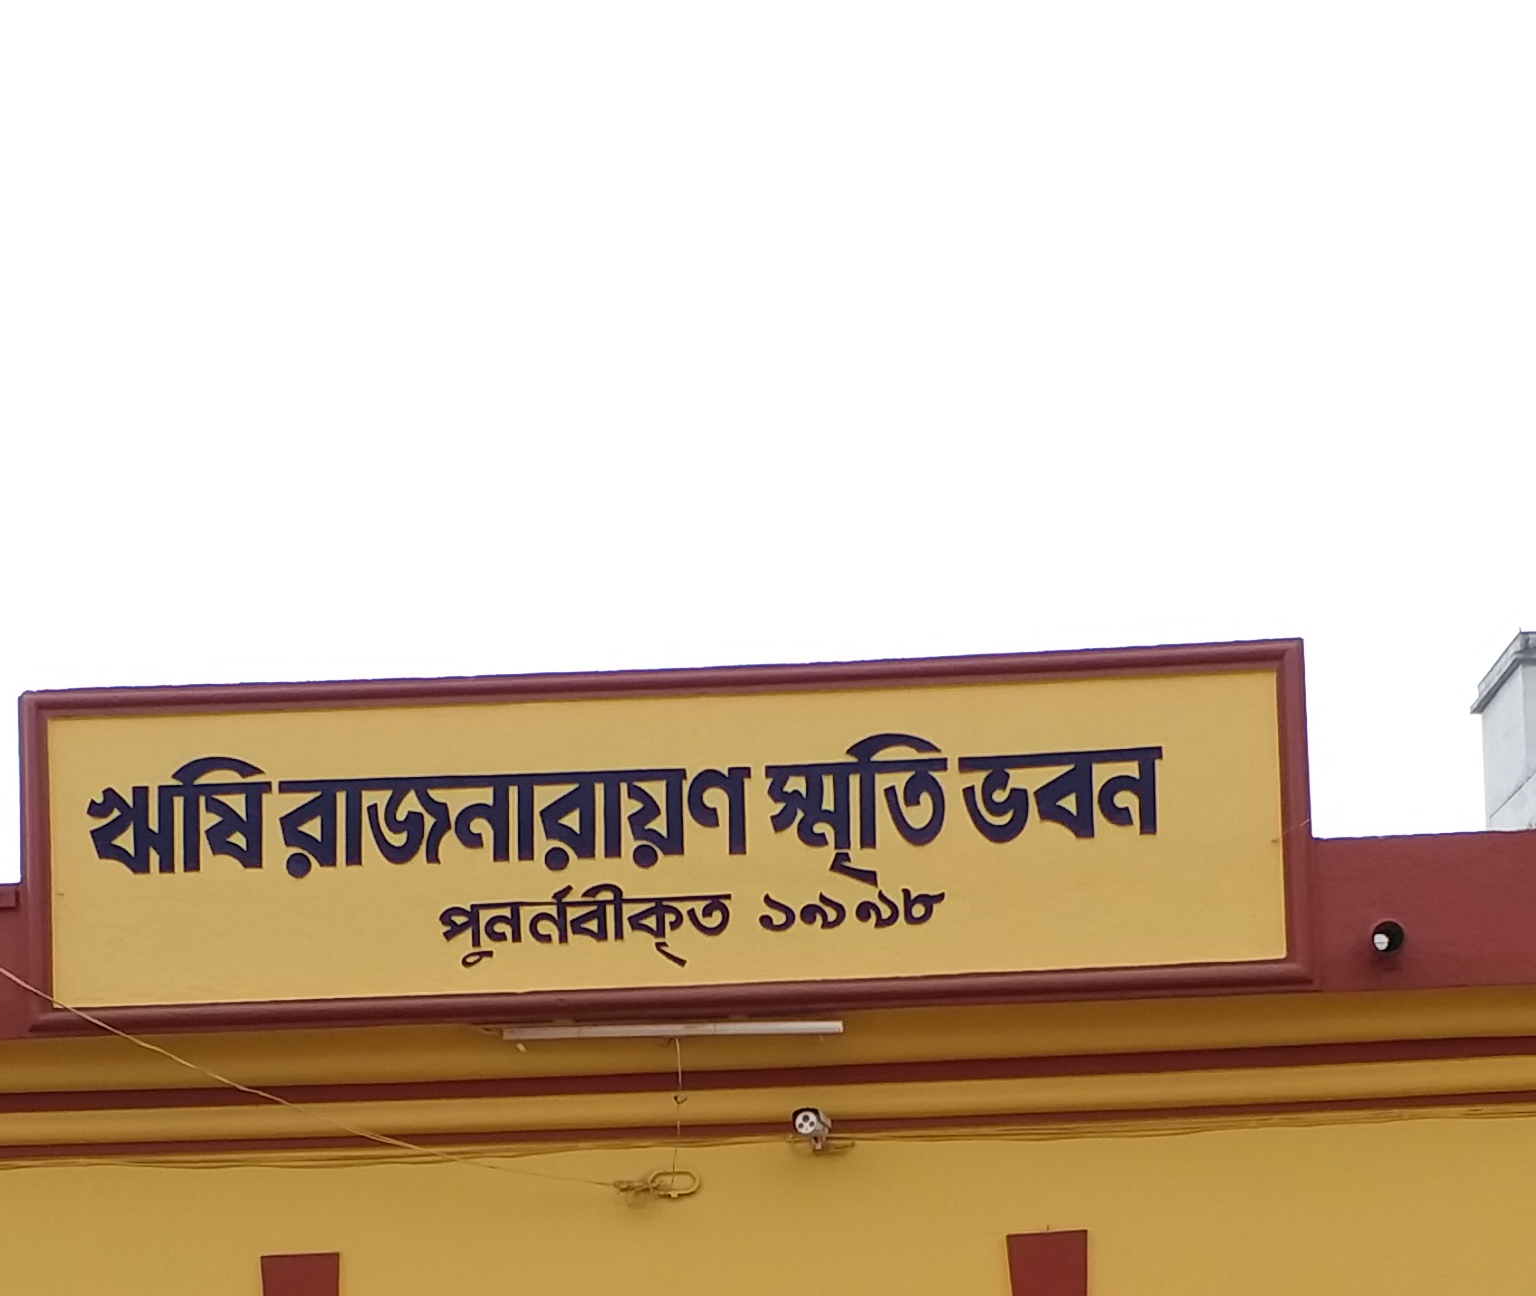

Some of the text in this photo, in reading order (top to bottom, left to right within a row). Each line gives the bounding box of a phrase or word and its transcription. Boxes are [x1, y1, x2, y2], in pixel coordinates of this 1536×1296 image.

[86, 732, 1164, 888] ঋষি রাজনারায়ণ স্মৃতি ভবন
[438, 883, 946, 968] পুনর্নবীকৃত ১৯৯৮
